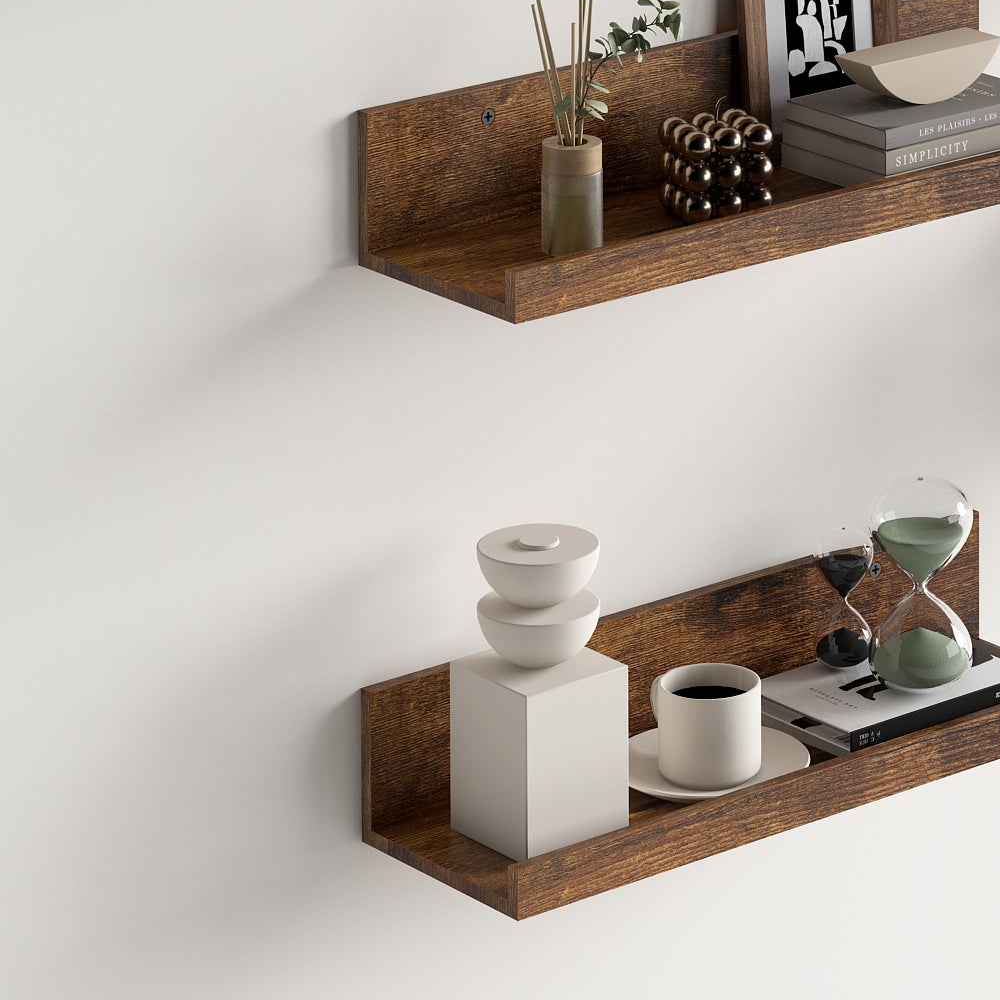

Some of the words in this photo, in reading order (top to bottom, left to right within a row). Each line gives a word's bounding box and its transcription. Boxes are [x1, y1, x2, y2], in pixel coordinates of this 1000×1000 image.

[919, 125, 934, 137] LES
[937, 117, 976, 133] PLAISIRS
[984, 111, 998, 122] LES
[895, 139, 970, 168] SIMPLICITY
